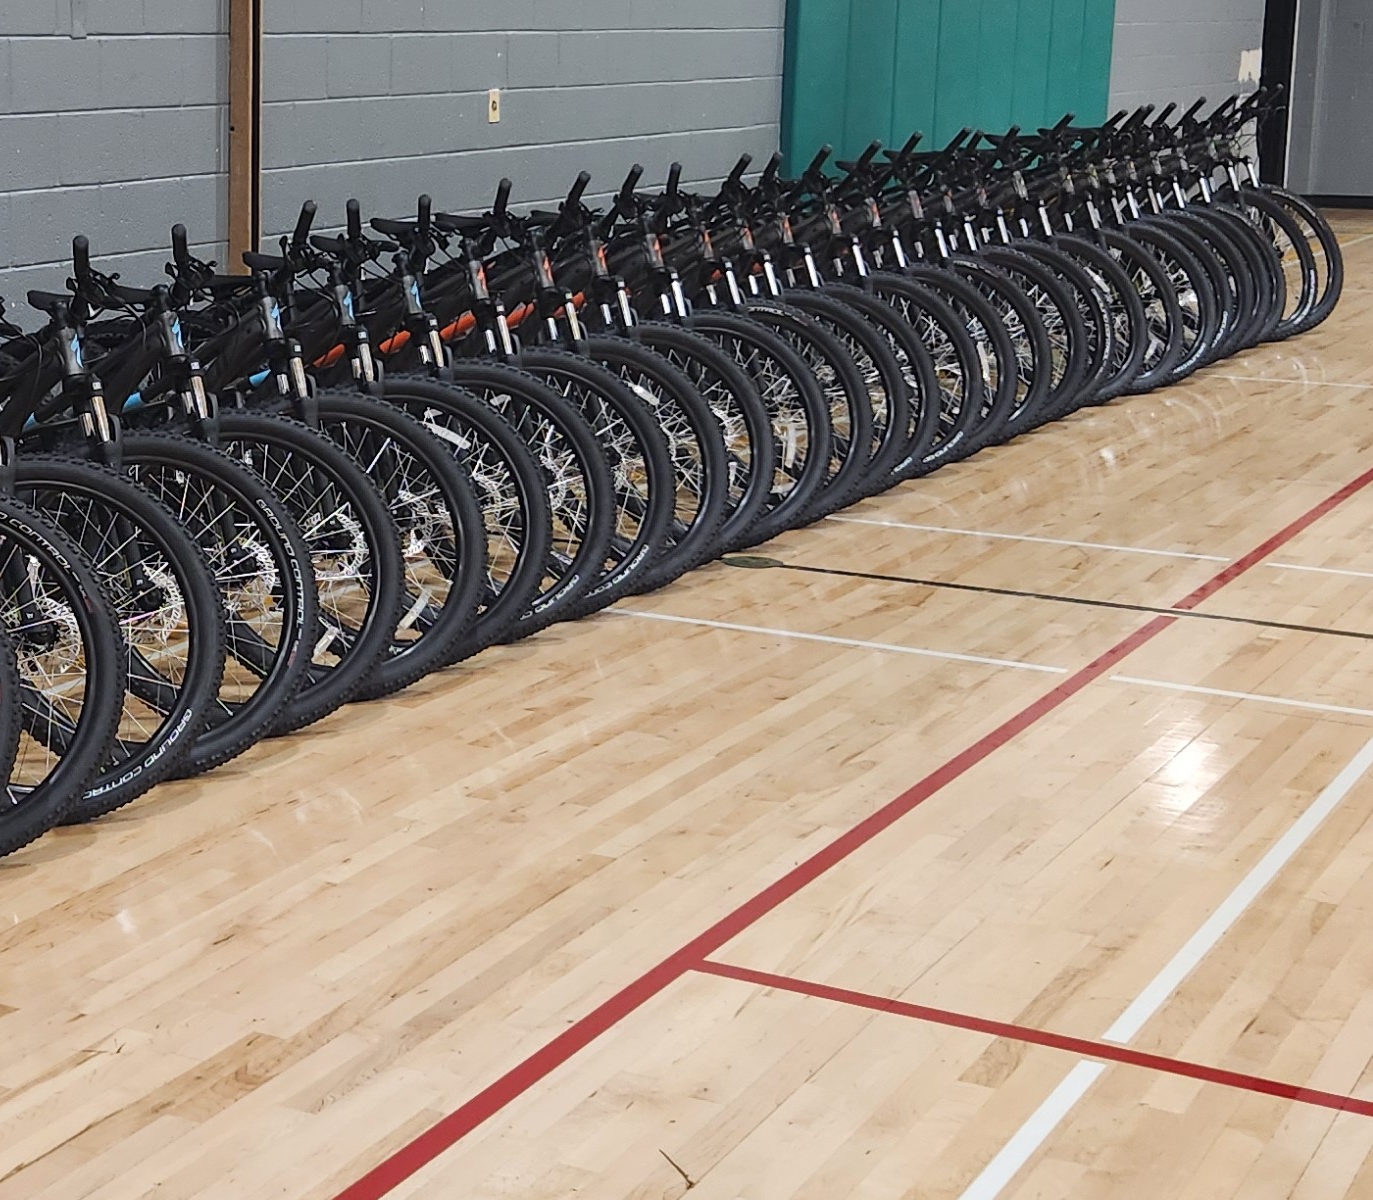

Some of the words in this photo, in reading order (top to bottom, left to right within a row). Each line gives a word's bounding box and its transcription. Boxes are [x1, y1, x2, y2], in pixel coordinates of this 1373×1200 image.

[9, 518, 72, 575] CONTROL
[255, 498, 296, 557] GROUND
[290, 558, 305, 629] CONTROL
[144, 708, 193, 768] GROUND
[82, 765, 143, 800] CONTRO
